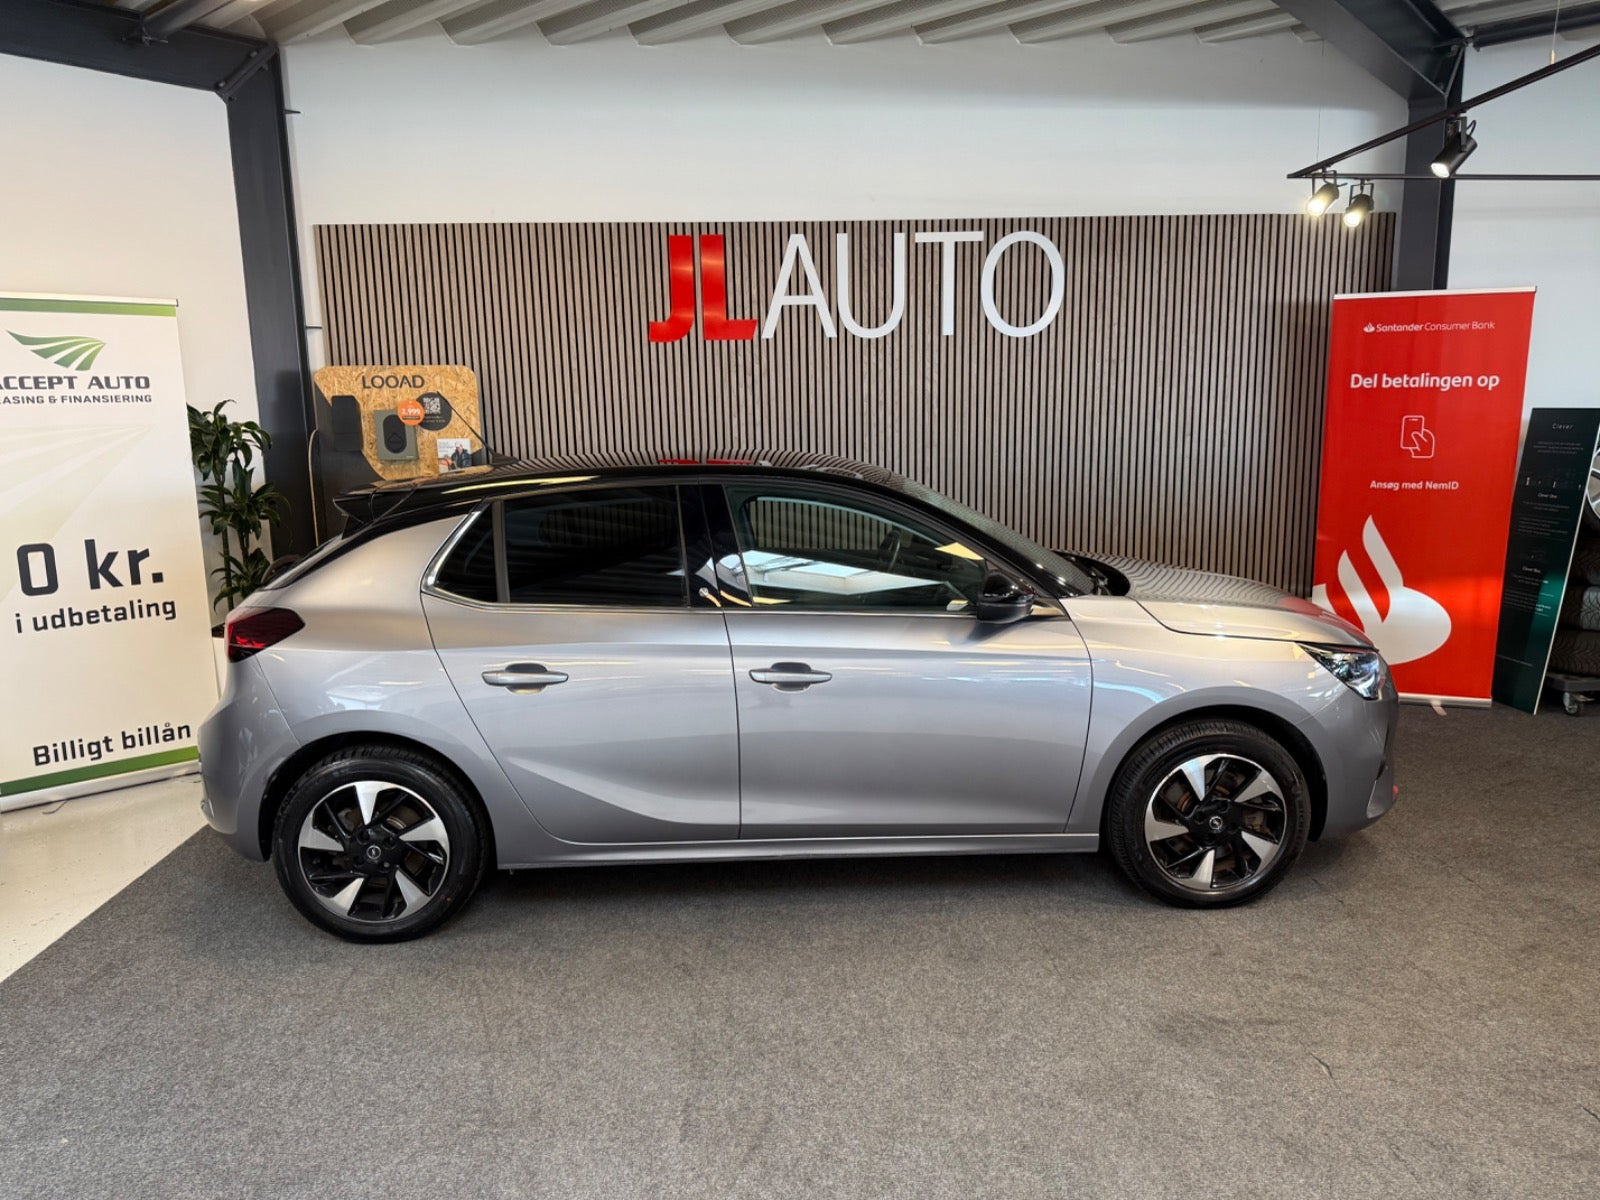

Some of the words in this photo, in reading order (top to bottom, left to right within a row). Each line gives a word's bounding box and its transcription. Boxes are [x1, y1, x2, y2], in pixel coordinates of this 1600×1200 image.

[648, 234, 758, 343] JL
[761, 230, 1065, 340] AUTO
[1376, 322, 1423, 332] Santander
[1424, 321, 1471, 331] Consumer
[1471, 320, 1495, 330] Bank
[0, 376, 77, 390] CCEPT
[87, 376, 150, 390] AUTO
[362, 375, 425, 389] LOOAD
[1350, 373, 1378, 388] Del
[1381, 372, 1473, 391] betalingen
[1477, 375, 1500, 391] op
[0, 395, 45, 405] ASING
[48, 395, 58, 404] &
[60, 394, 152, 404] FINANSIERING
[1370, 480, 1399, 491] Ansøg
[1401, 480, 1423, 490] med
[1425, 481, 1459, 490] NemID
[84, 539, 164, 590] kr.
[15, 612, 23, 634] i
[32, 599, 177, 632] udbetaling
[33, 735, 114, 767] Billigt
[121, 722, 191, 750] billån
